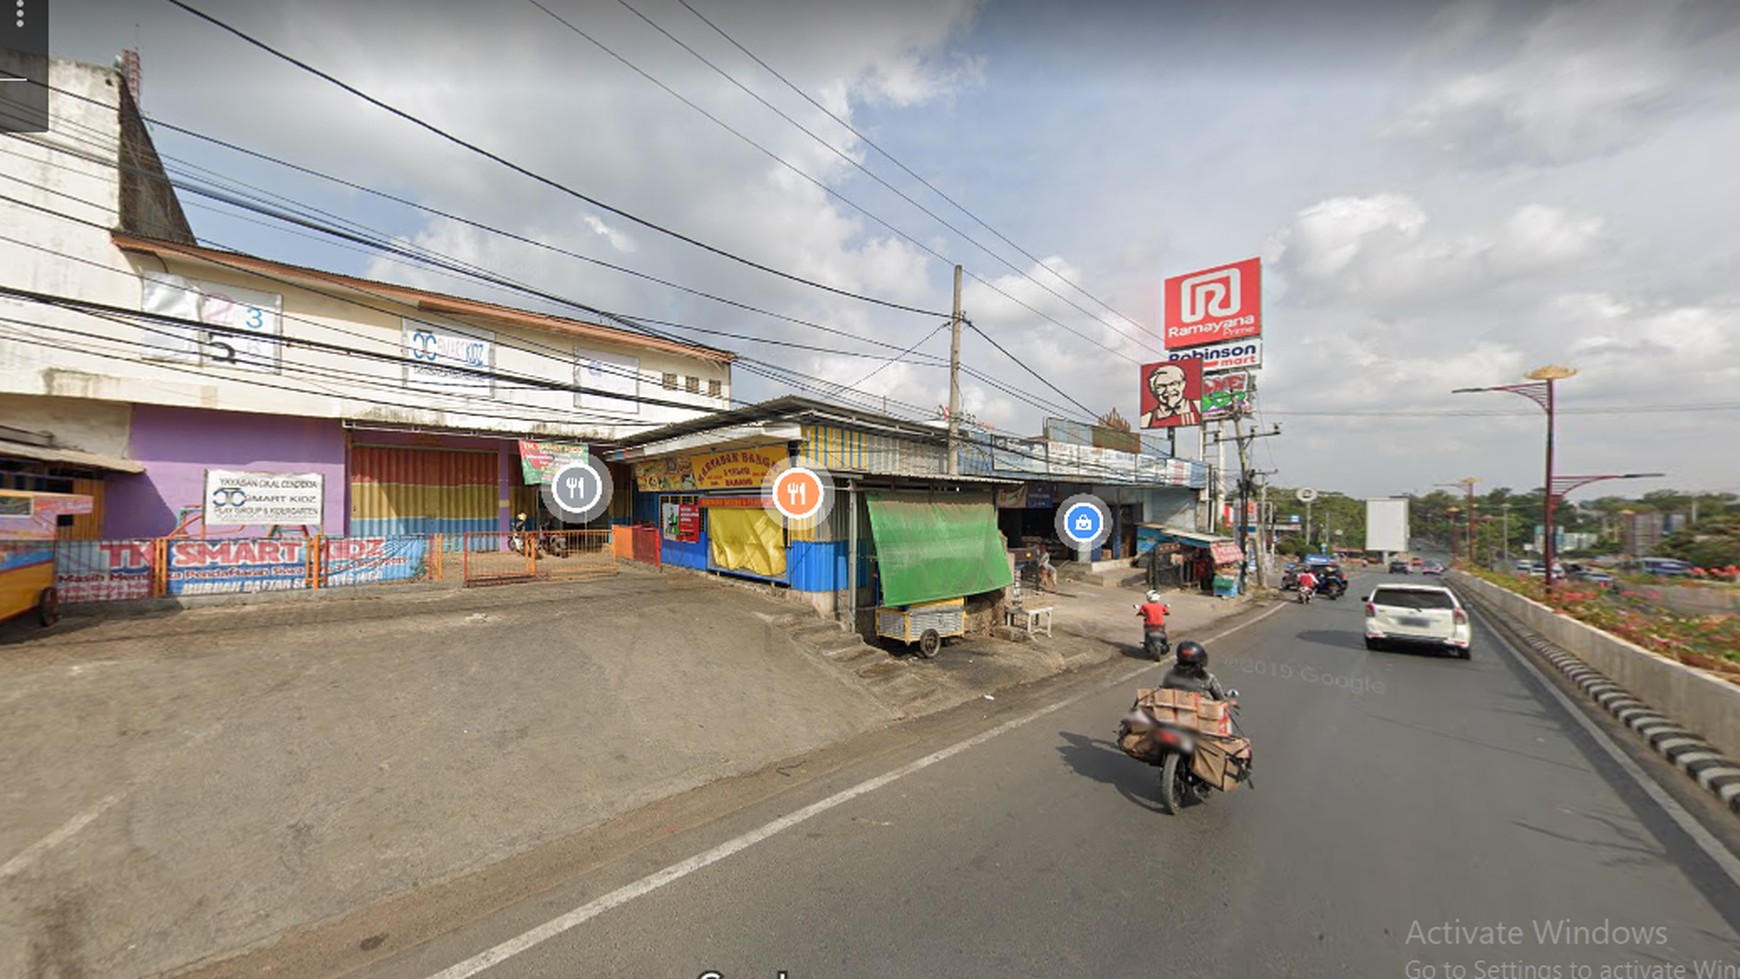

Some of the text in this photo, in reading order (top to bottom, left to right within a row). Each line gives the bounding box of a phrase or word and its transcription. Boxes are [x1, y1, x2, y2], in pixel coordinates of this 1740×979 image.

[245, 307, 264, 329] 3
[1167, 314, 1255, 338] Ramayana
[1223, 325, 1255, 336] Prime
[207, 331, 236, 362] 5
[1220, 354, 1256, 367] mart
[100, 540, 154, 570] TK
[173, 540, 303, 568] SMART
